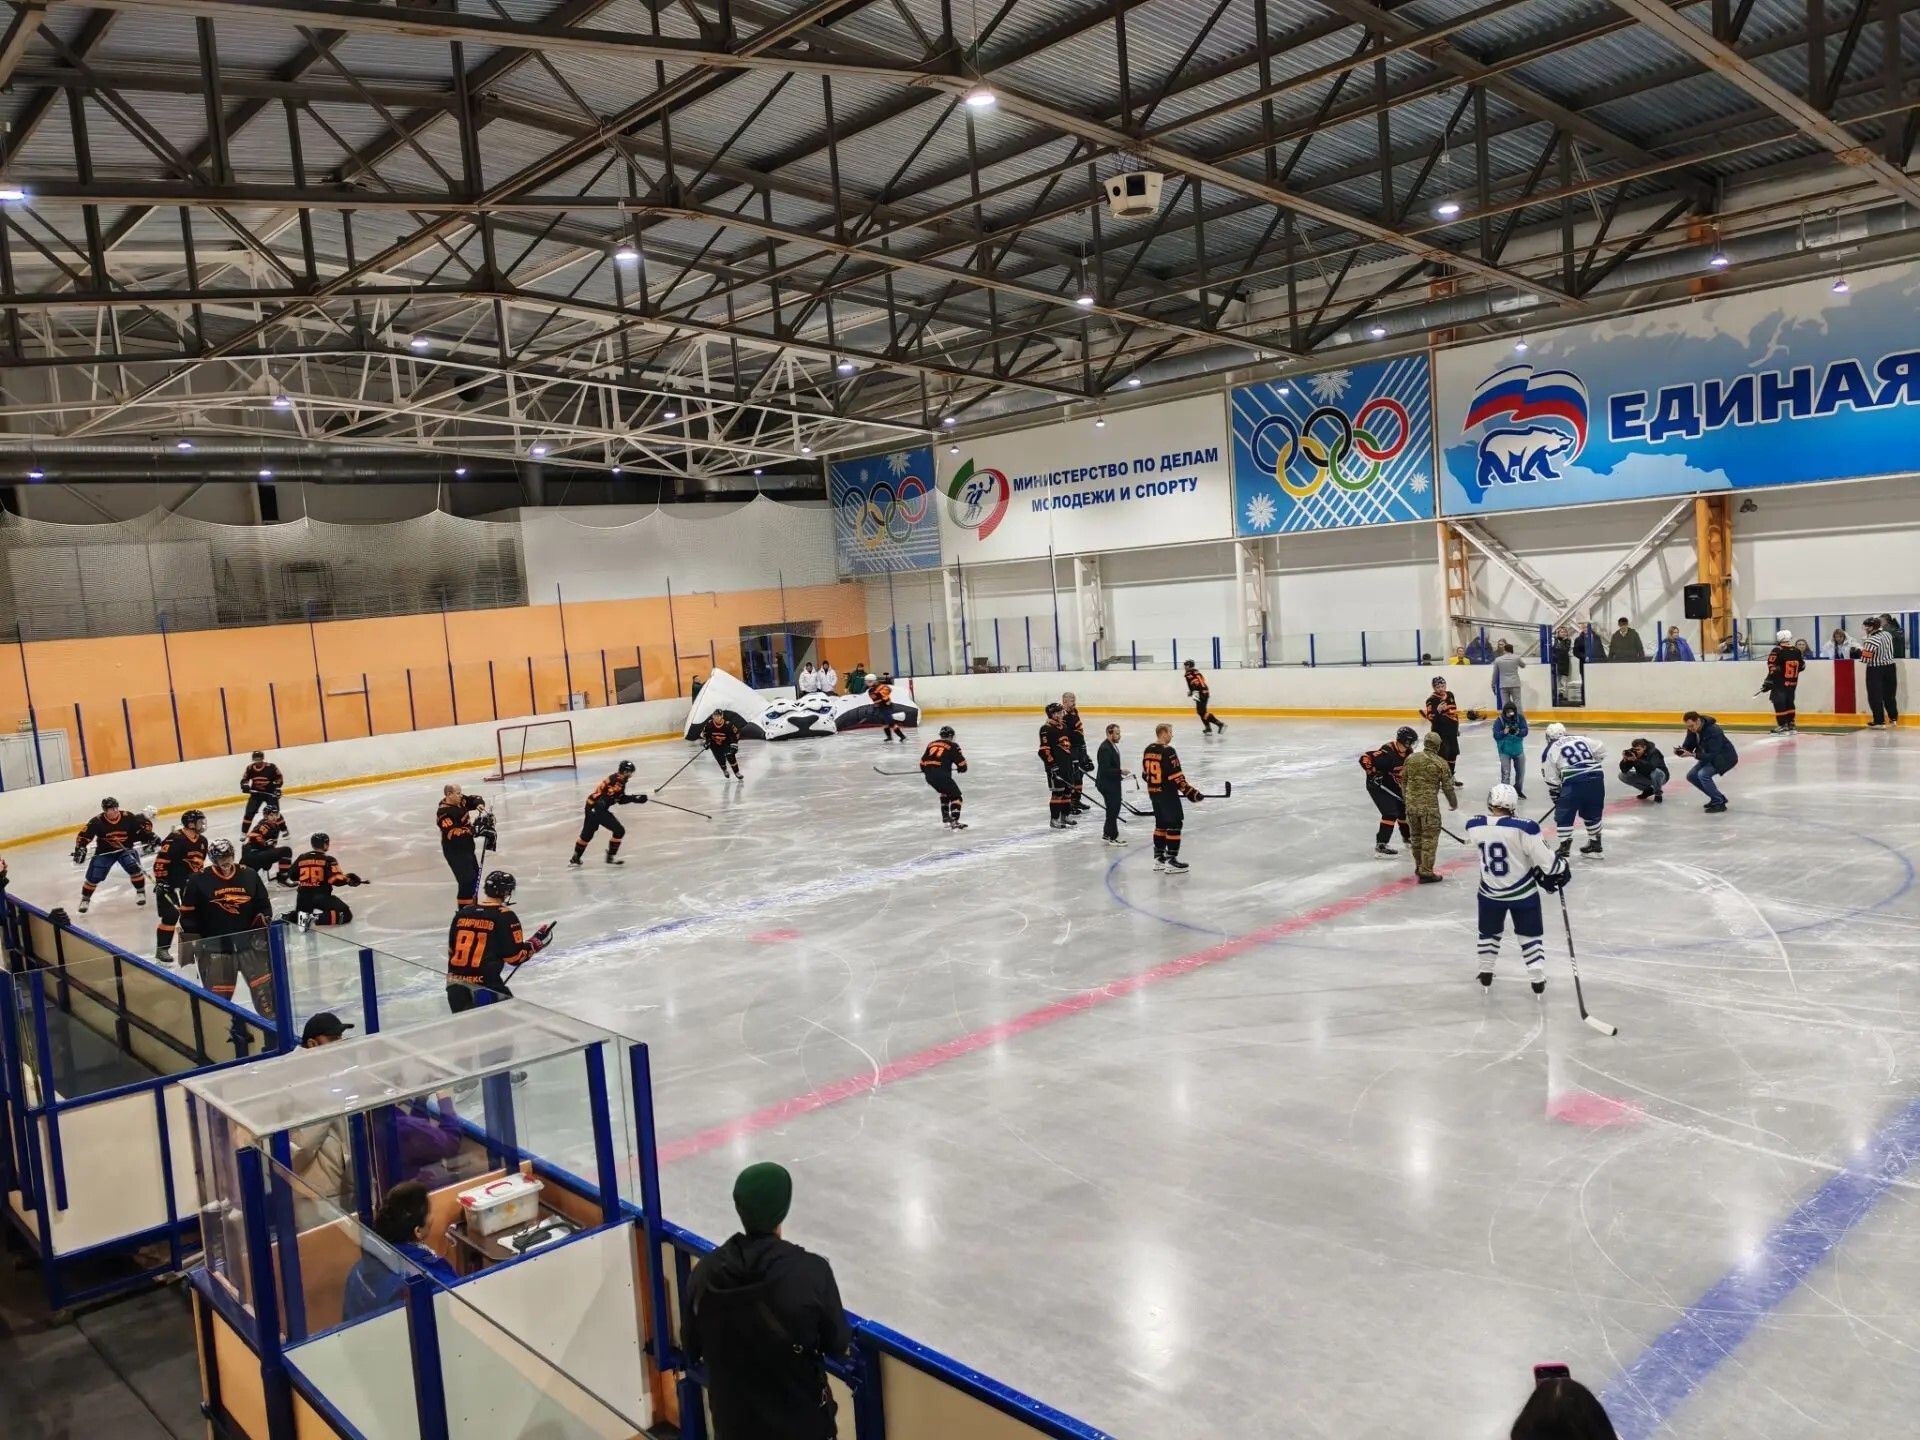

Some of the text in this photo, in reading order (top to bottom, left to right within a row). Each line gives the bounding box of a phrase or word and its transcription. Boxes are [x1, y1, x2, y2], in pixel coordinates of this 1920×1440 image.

[1608, 349, 1920, 443] ЕДИНАЯ
[1013, 447, 1219, 492] МИНИСТЕРСТВО ПО ДЕЛАМ
[1031, 476, 1199, 513] МОЛОДЕЖИ И СПОРТУ
[1561, 740, 1594, 766] 88
[1478, 841, 1511, 877] 18
[450, 930, 488, 967] 81
